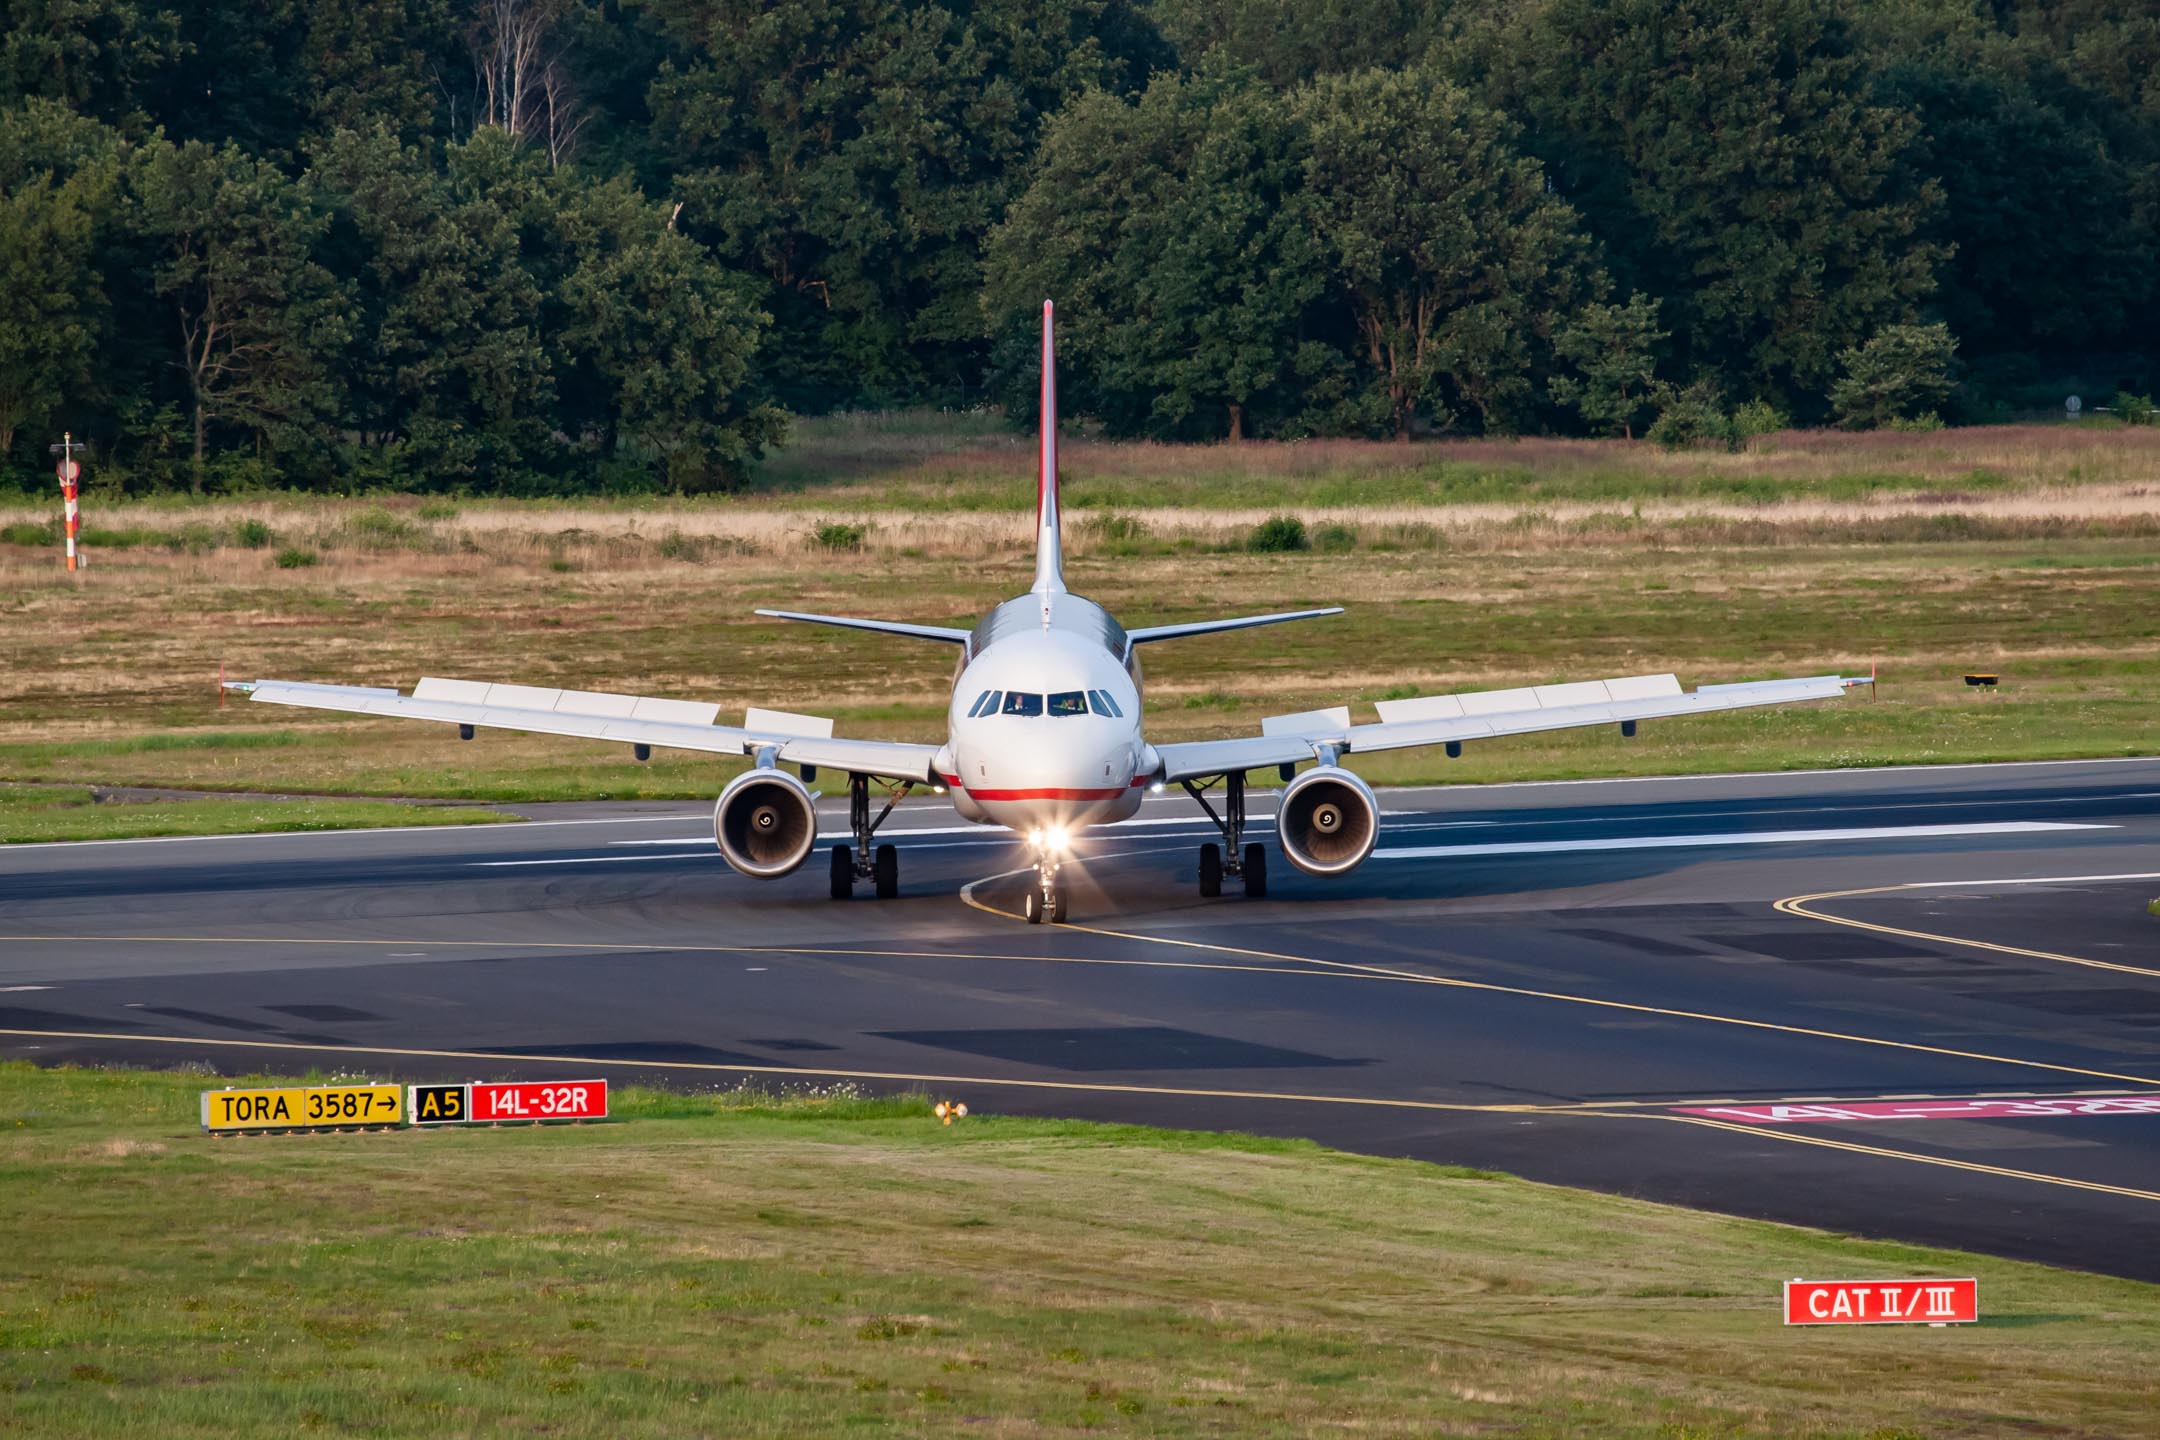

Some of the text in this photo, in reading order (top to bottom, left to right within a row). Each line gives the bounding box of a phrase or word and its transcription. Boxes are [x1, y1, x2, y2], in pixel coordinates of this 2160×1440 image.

[221, 1092, 374, 1121] TORA 3587
[421, 1091, 460, 1117] A5
[489, 1086, 588, 1115] 14L-32R
[1808, 1287, 1956, 1318] CAT II/III
